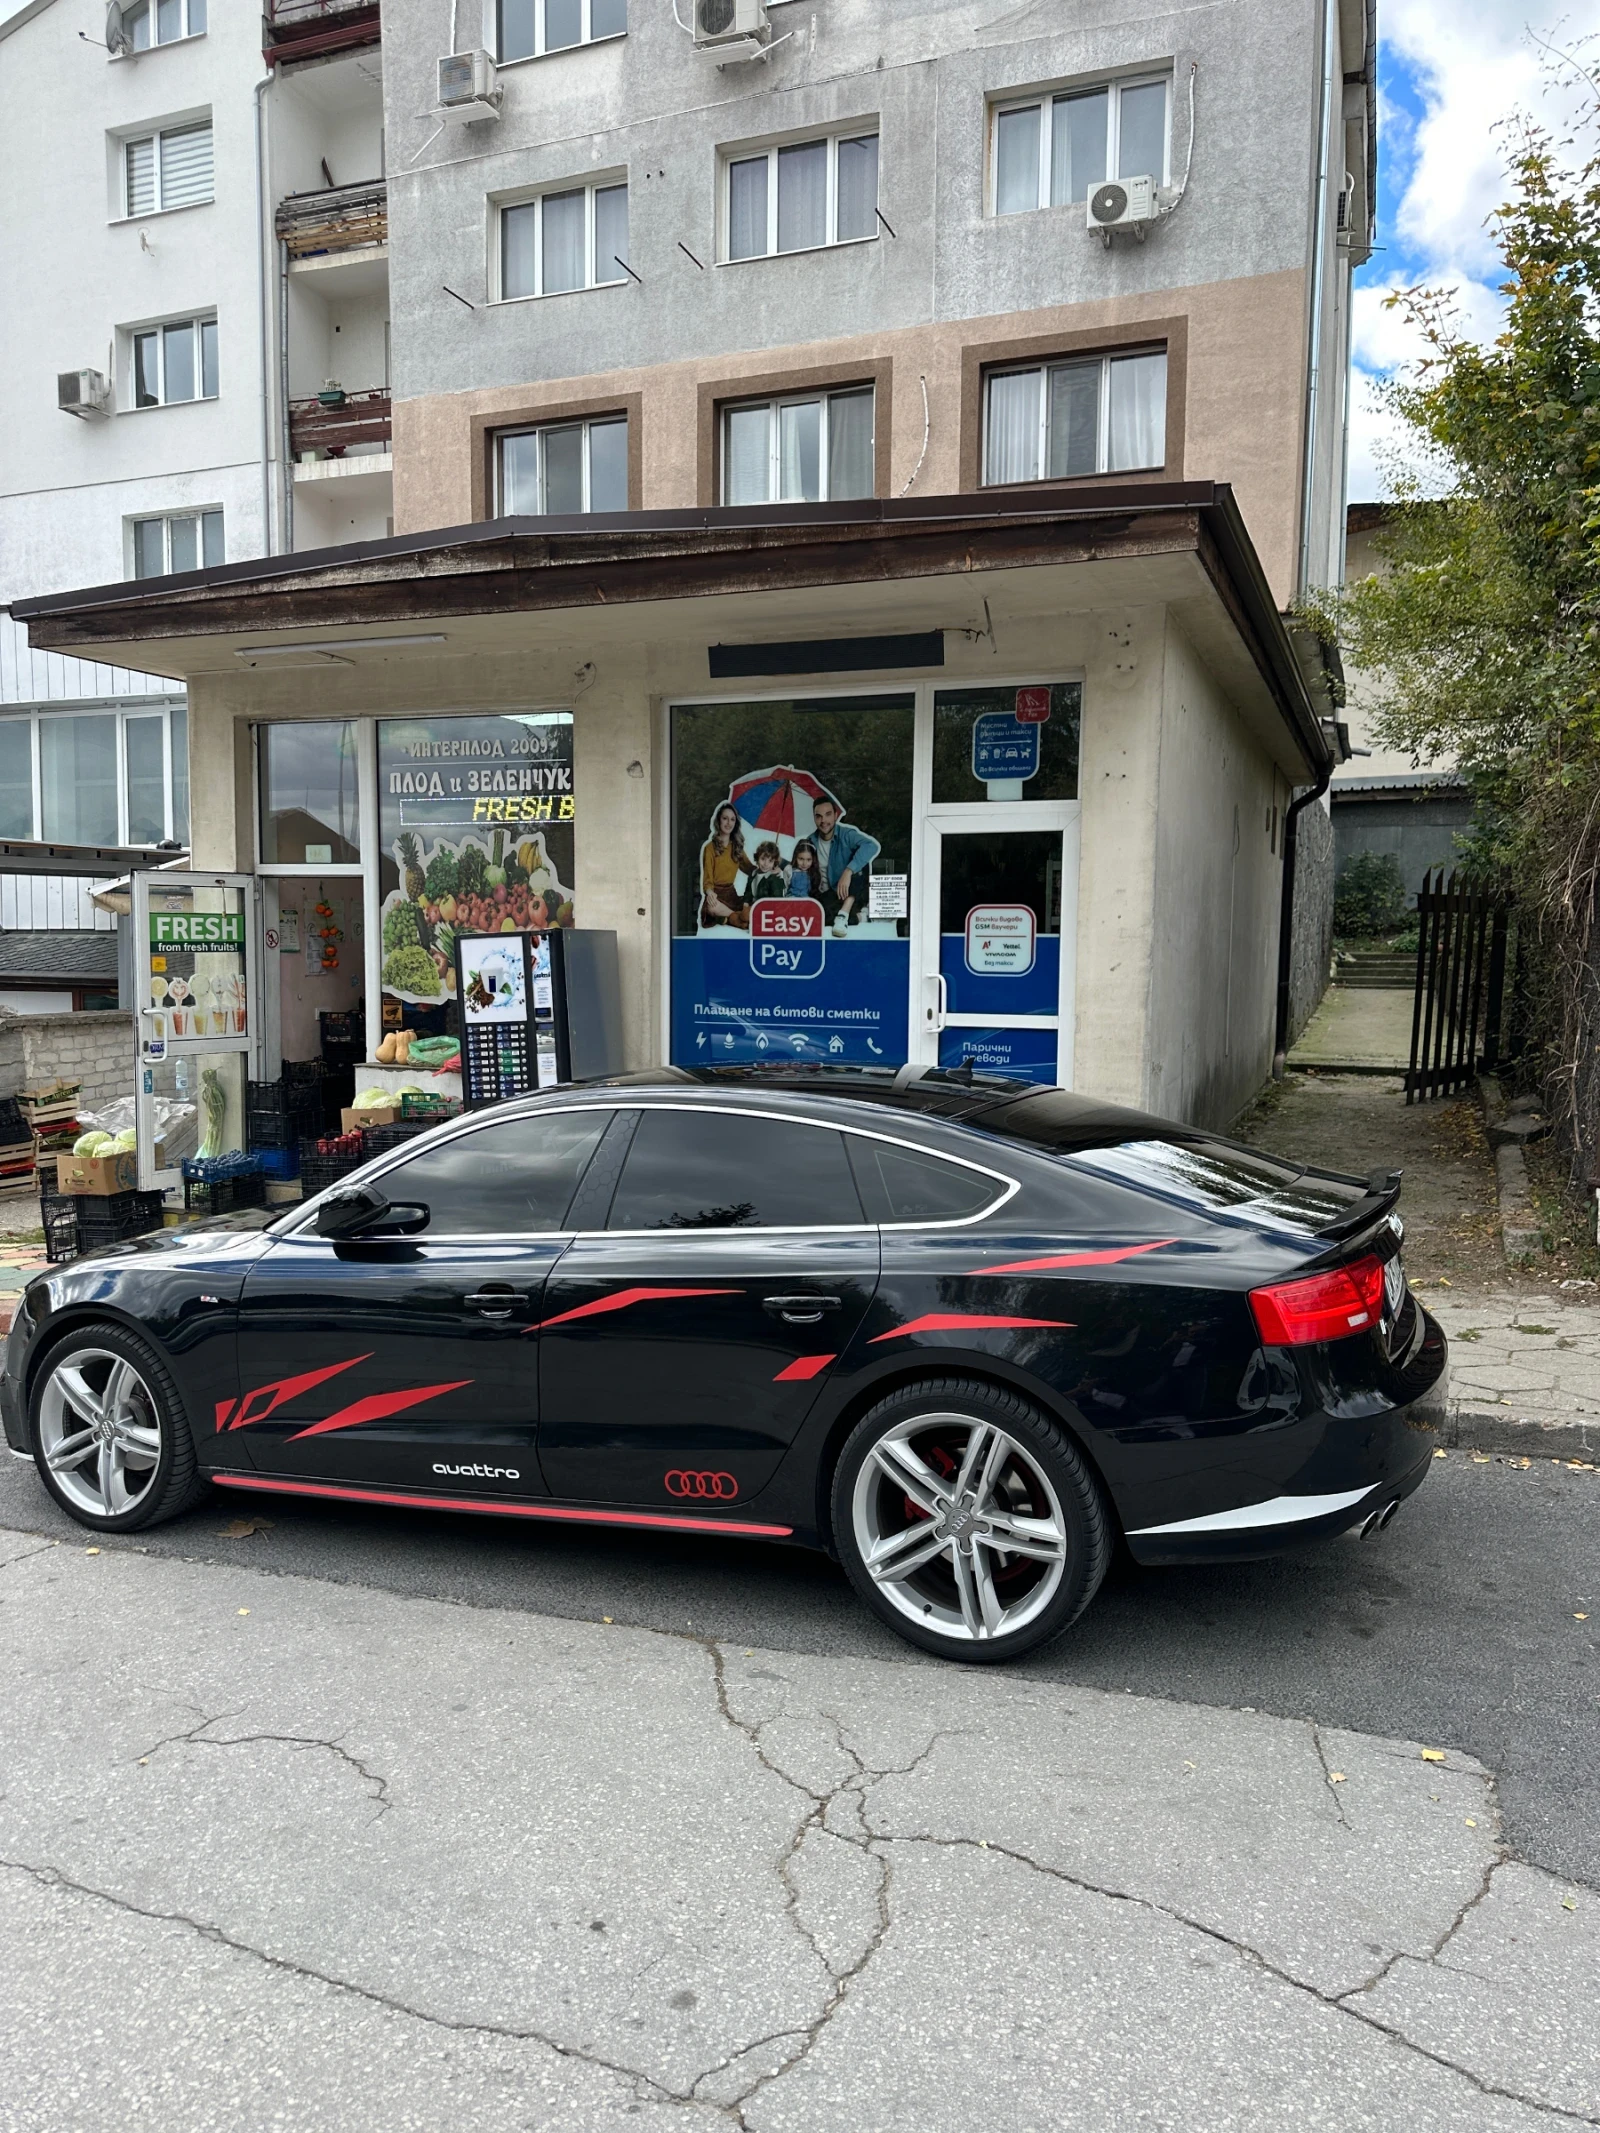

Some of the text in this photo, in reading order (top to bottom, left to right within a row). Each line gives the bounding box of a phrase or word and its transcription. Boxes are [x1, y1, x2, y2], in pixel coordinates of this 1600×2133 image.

[410, 738, 548, 758] ИНТЕРПЛОД 2009
[389, 767, 572, 797] ПЛОД и ЗЕЛЕНЧУК
[472, 796, 553, 821] FRESH
[156, 916, 238, 940] FRESH
[761, 910, 815, 937] Easy
[158, 942, 238, 952] from fresh fruits!
[761, 943, 803, 971] Pay
[694, 1003, 881, 1020] Плащане на битови сметки
[962, 1041, 1012, 1053] Парични
[432, 1463, 520, 1479] quattro
